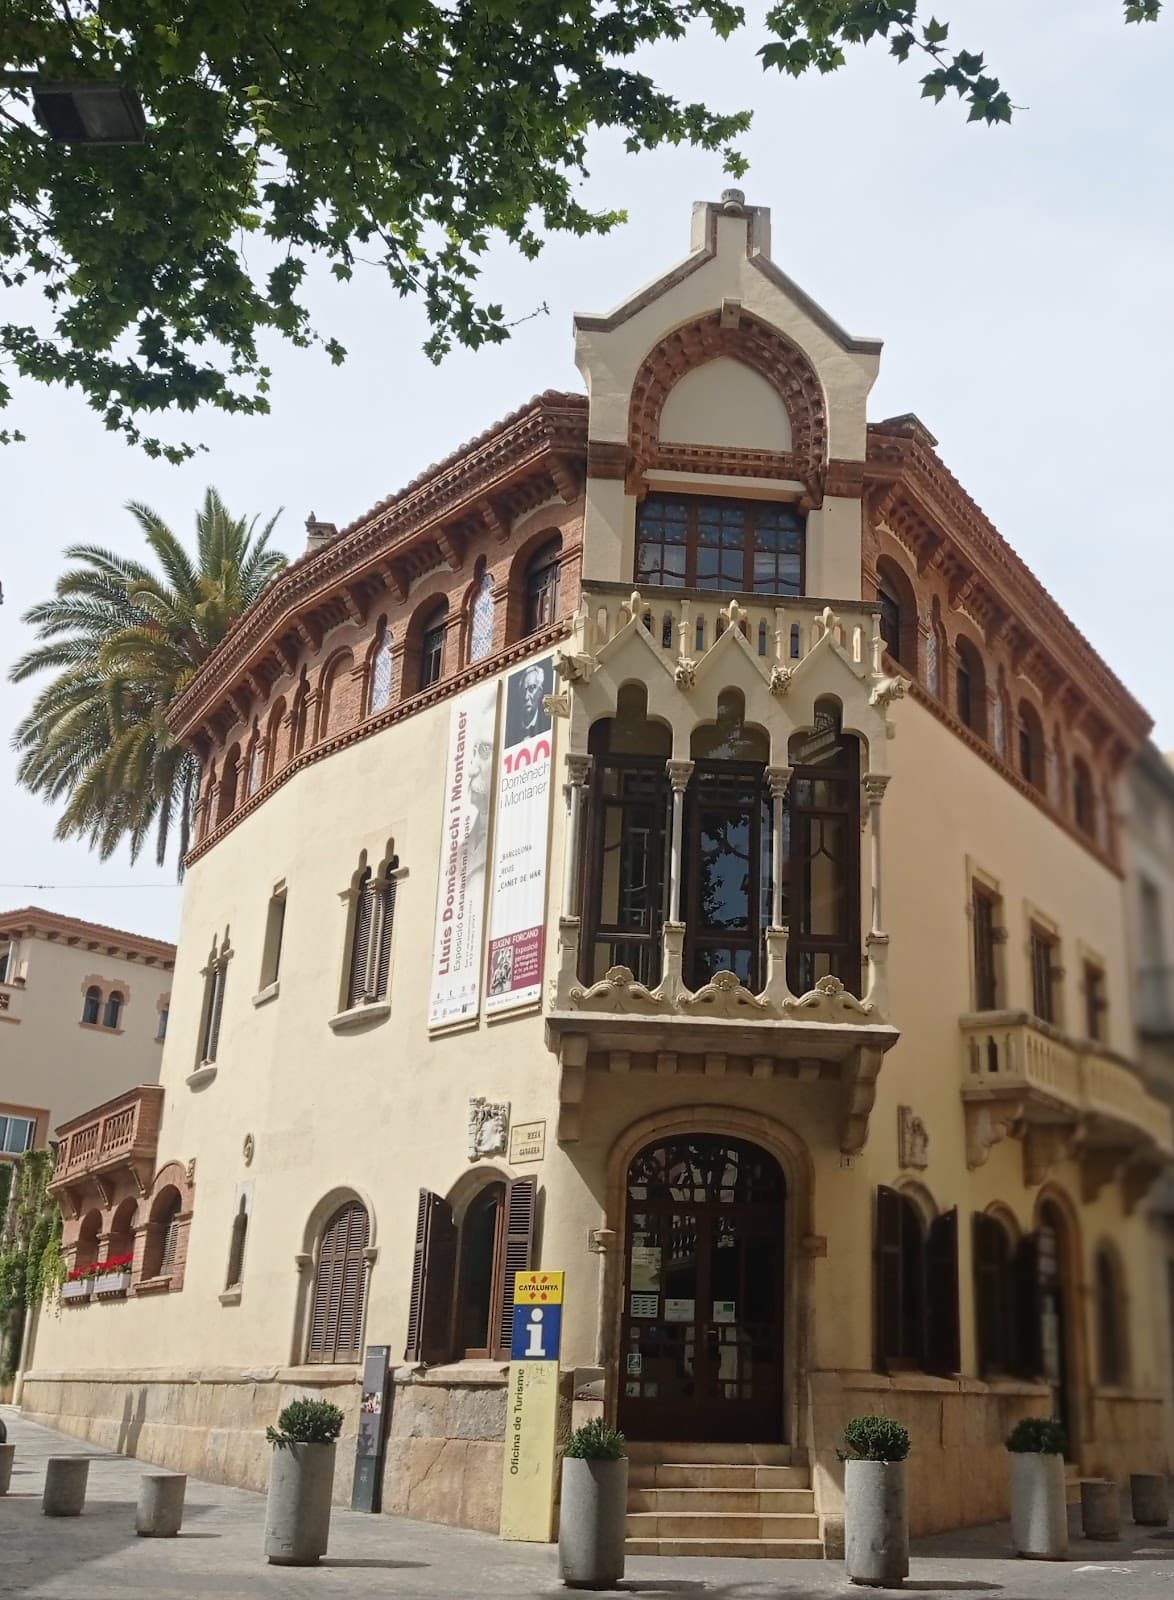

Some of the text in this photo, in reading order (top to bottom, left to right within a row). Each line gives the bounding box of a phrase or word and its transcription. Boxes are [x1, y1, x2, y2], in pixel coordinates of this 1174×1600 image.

[504, 740, 550, 775] 100
[501, 761, 549, 793] Domènech
[504, 781, 547, 808] Montaner
[438, 711, 468, 976] Lluís Domènech i Montaner
[518, 1284, 559, 1292] CATALUNYA
[512, 1416, 522, 1431] de
[509, 1434, 521, 1475] Oficina
